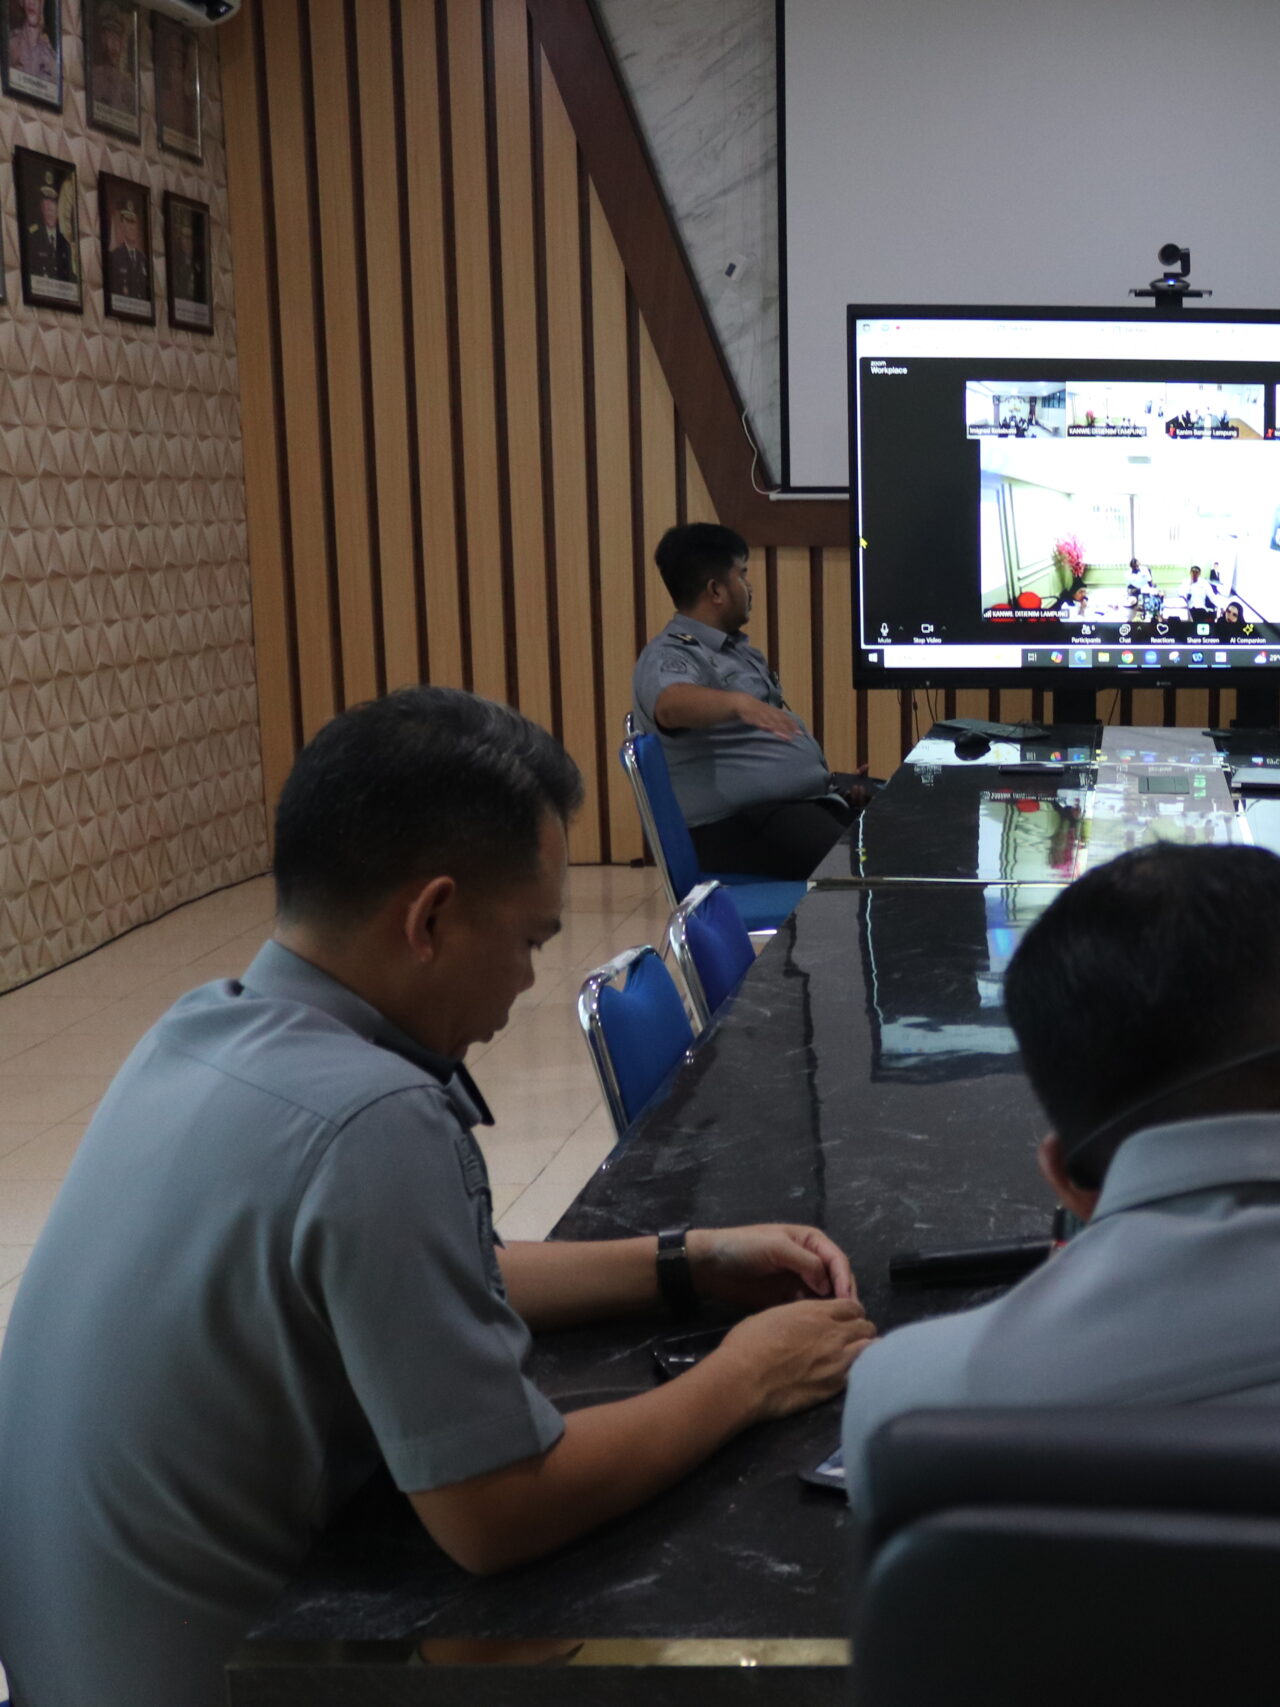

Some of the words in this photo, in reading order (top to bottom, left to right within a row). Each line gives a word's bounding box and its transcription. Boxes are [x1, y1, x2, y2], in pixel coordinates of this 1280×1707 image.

[871, 367, 908, 375] Workplace
[913, 637, 926, 645] Stop
[1237, 637, 1266, 645] Companion
